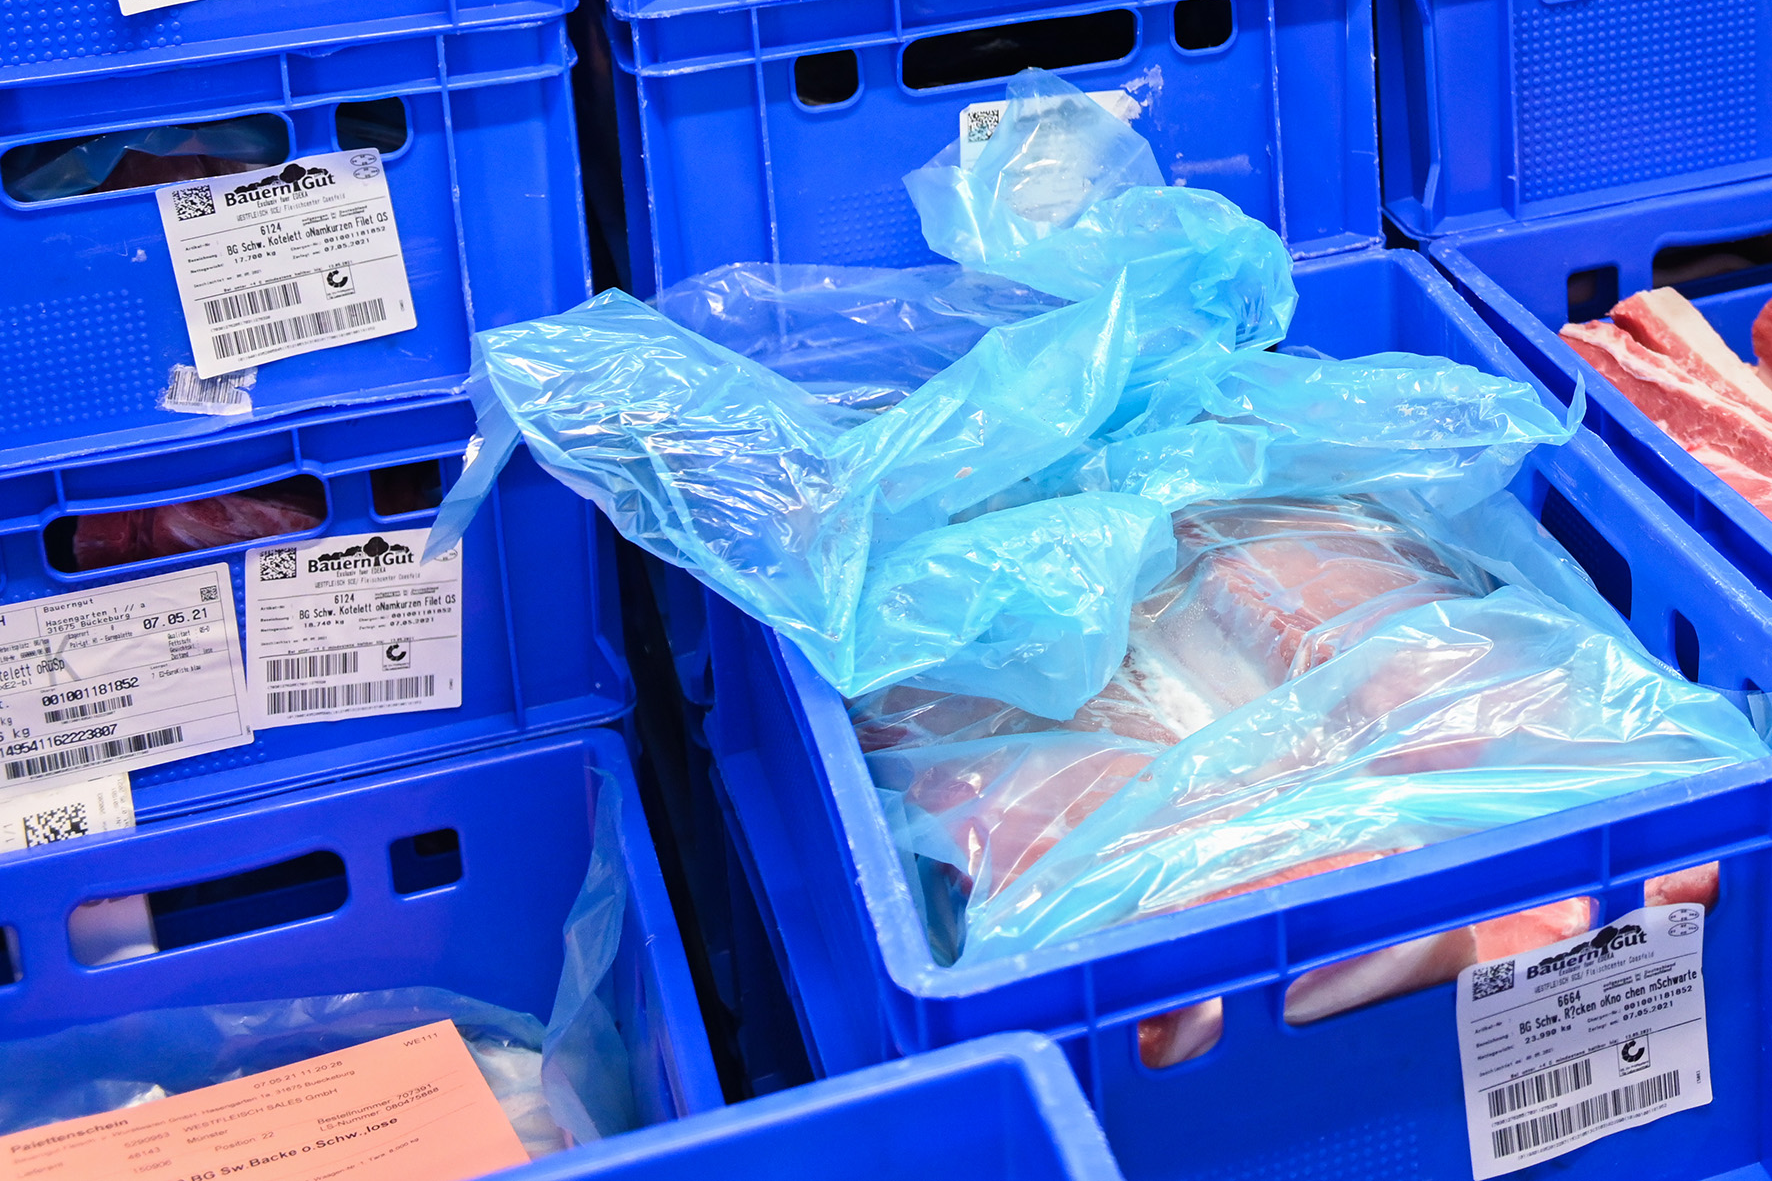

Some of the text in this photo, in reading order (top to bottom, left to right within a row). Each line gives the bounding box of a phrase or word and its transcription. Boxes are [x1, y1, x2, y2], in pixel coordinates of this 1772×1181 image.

[224, 174, 335, 207] Bauern Gut
[227, 244, 238, 256] BG
[242, 241, 266, 253] Schw.
[268, 230, 302, 246] Kotelett
[355, 216, 374, 228] Filet
[377, 212, 389, 223] QS
[260, 223, 282, 235] 6124
[324, 226, 386, 244] 001001181852
[324, 239, 370, 253] 07.05.2021
[308, 553, 414, 573] Bauern Gut
[43, 598, 94, 614] Bauerngut
[299, 610, 310, 619] BG
[313, 608, 336, 618] Schw.
[339, 603, 372, 615] Kotelett
[425, 596, 442, 606] Filet
[445, 595, 456, 604] QS
[334, 594, 355, 604] 6124
[45, 610, 107, 628] Hasengarten
[143, 608, 208, 630] 07.05.21
[390, 617, 434, 626] 07.05.2021
[391, 608, 451, 619] 001001181852
[47, 612, 131, 634] 31675 Bückeburg
[42, 676, 140, 707] 001001181852
[13, 728, 30, 738] kg
[1526, 949, 1599, 980] Bauern
[1610, 930, 1648, 951] Gut
[1519, 1022, 1532, 1035] BG
[1536, 1013, 1561, 1030] Schw.
[1625, 984, 1646, 999] chen
[1649, 969, 1697, 993] mSchwarte
[1557, 990, 1581, 1008] 6664
[1623, 985, 1693, 1011] 001001181852
[1622, 1001, 1673, 1020] 07.05.2021
[403, 1033, 438, 1047] WE111
[266, 1097, 302, 1111] SALES
[305, 1088, 338, 1101] GmbH
[397, 1083, 432, 1100] 707391
